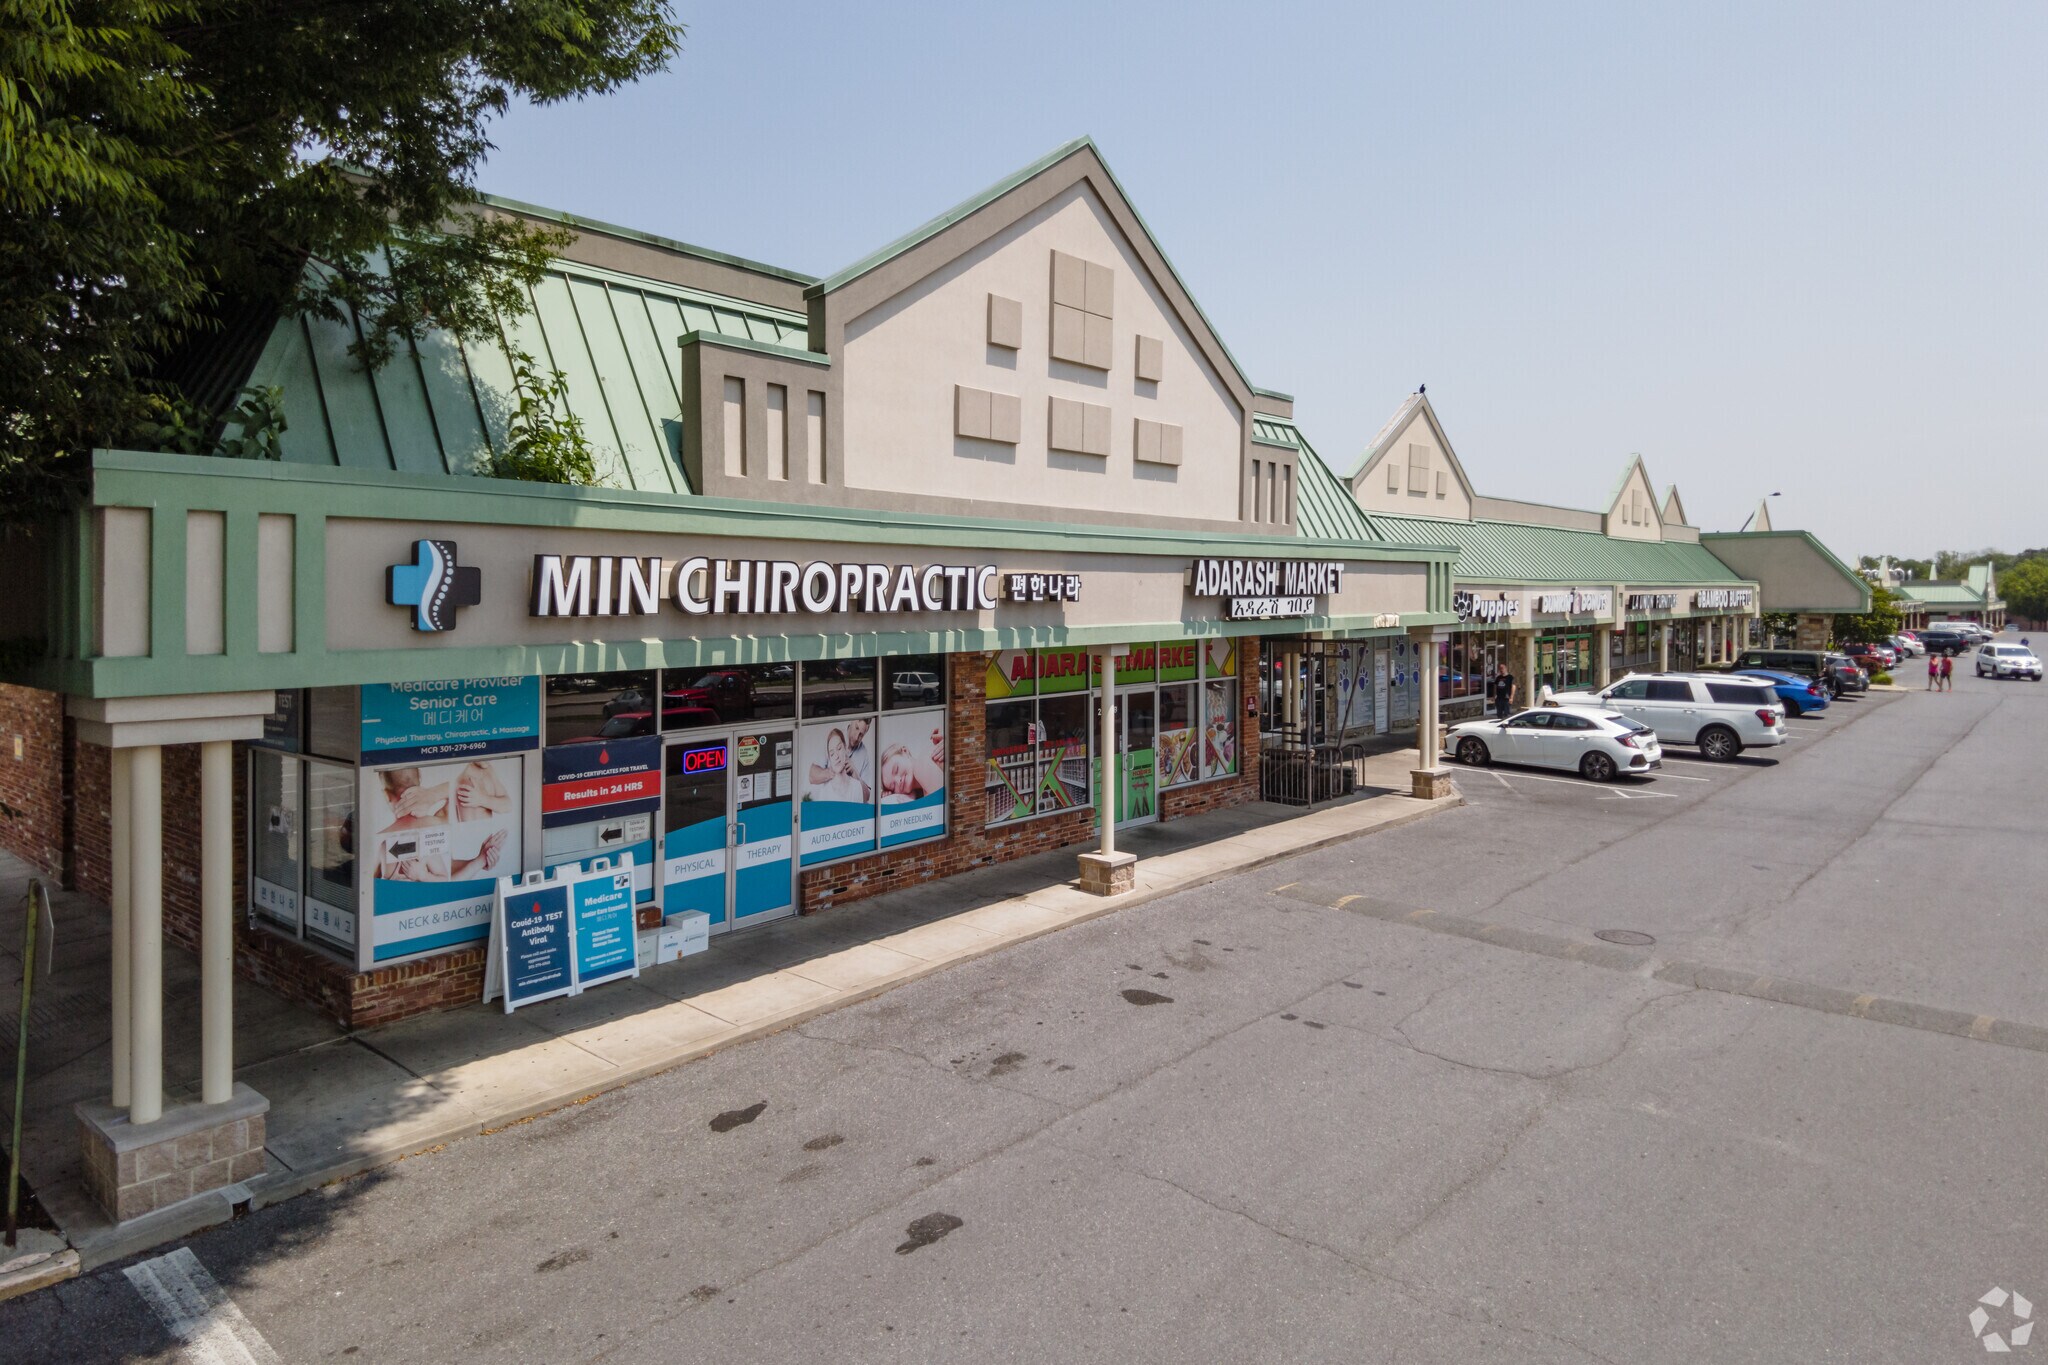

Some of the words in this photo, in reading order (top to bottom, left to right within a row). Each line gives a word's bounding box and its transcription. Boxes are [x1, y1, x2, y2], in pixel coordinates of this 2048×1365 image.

[529, 554, 662, 617] MIN
[669, 556, 997, 614] CHIROPRACTIC
[1194, 559, 1277, 596] ADARASH
[1283, 562, 1345, 595] MARKET
[1008, 573, 1081, 602] 편한나라
[1472, 592, 1520, 624] Puppies
[391, 679, 459, 693] Medicare
[464, 675, 524, 690] Provider
[410, 695, 458, 711] Senior
[463, 694, 497, 707] Care
[423, 708, 484, 726] 메디케어
[375, 733, 408, 744] Physical
[499, 725, 530, 735] Massage
[420, 746, 438, 755] MCR
[439, 742, 487, 753] 301-279-6960
[685, 749, 725, 771] OPEN
[558, 772, 583, 781] COVID-19
[583, 768, 619, 778] CERTIFICATES
[630, 764, 649, 772] TRAVEL
[564, 788, 598, 800] Results
[600, 786, 608, 796] in
[610, 784, 622, 794] 24
[624, 781, 643, 792] HRS
[889, 818, 904, 829] DRY
[903, 812, 933, 826] NEEDLING
[424, 838, 446, 846] TESTING
[811, 833, 831, 845] AUTO
[832, 826, 865, 841] ACCIDENT
[747, 844, 781, 859] THERAPY
[674, 858, 715, 875] PHYSICAL
[584, 891, 623, 907] Medicare
[398, 914, 430, 931] NECK
[432, 913, 440, 924] &
[443, 906, 473, 921] BACK
[474, 903, 494, 915] PAI
[545, 911, 563, 921] TEST
[521, 924, 555, 938] Antibody
[529, 935, 548, 946] Viral
